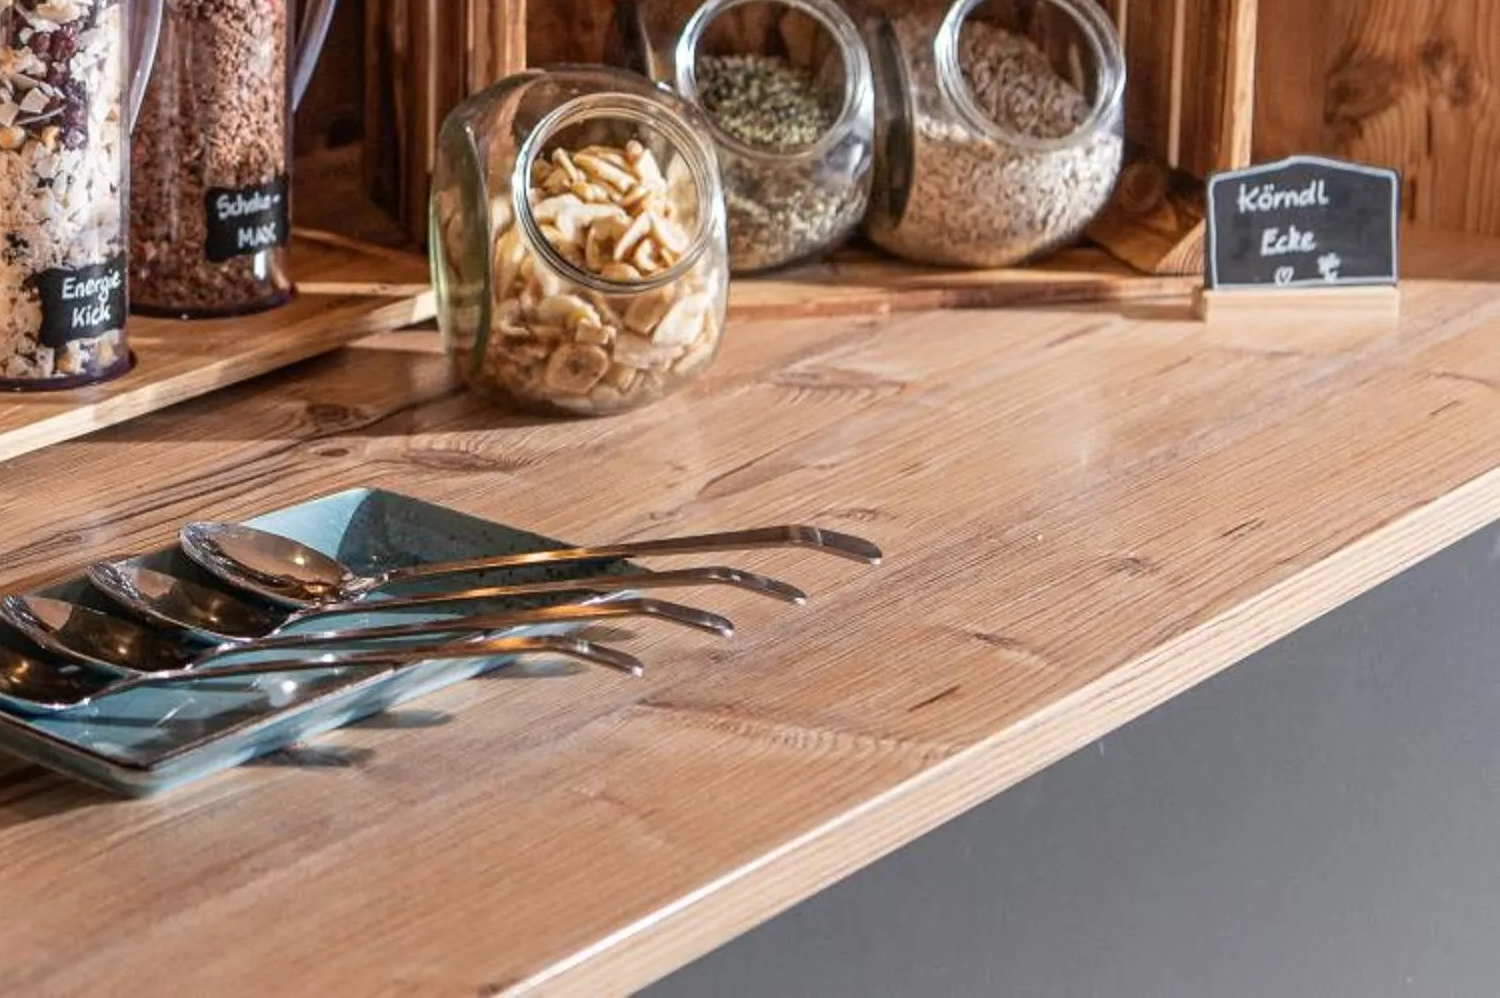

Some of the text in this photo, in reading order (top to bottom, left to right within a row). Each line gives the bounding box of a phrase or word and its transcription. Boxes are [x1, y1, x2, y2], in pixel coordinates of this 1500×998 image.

[1236, 180, 1329, 213] Körndl
[238, 222, 277, 249] MAX
[1260, 225, 1317, 256] Ecke
[72, 303, 111, 329] Kick
